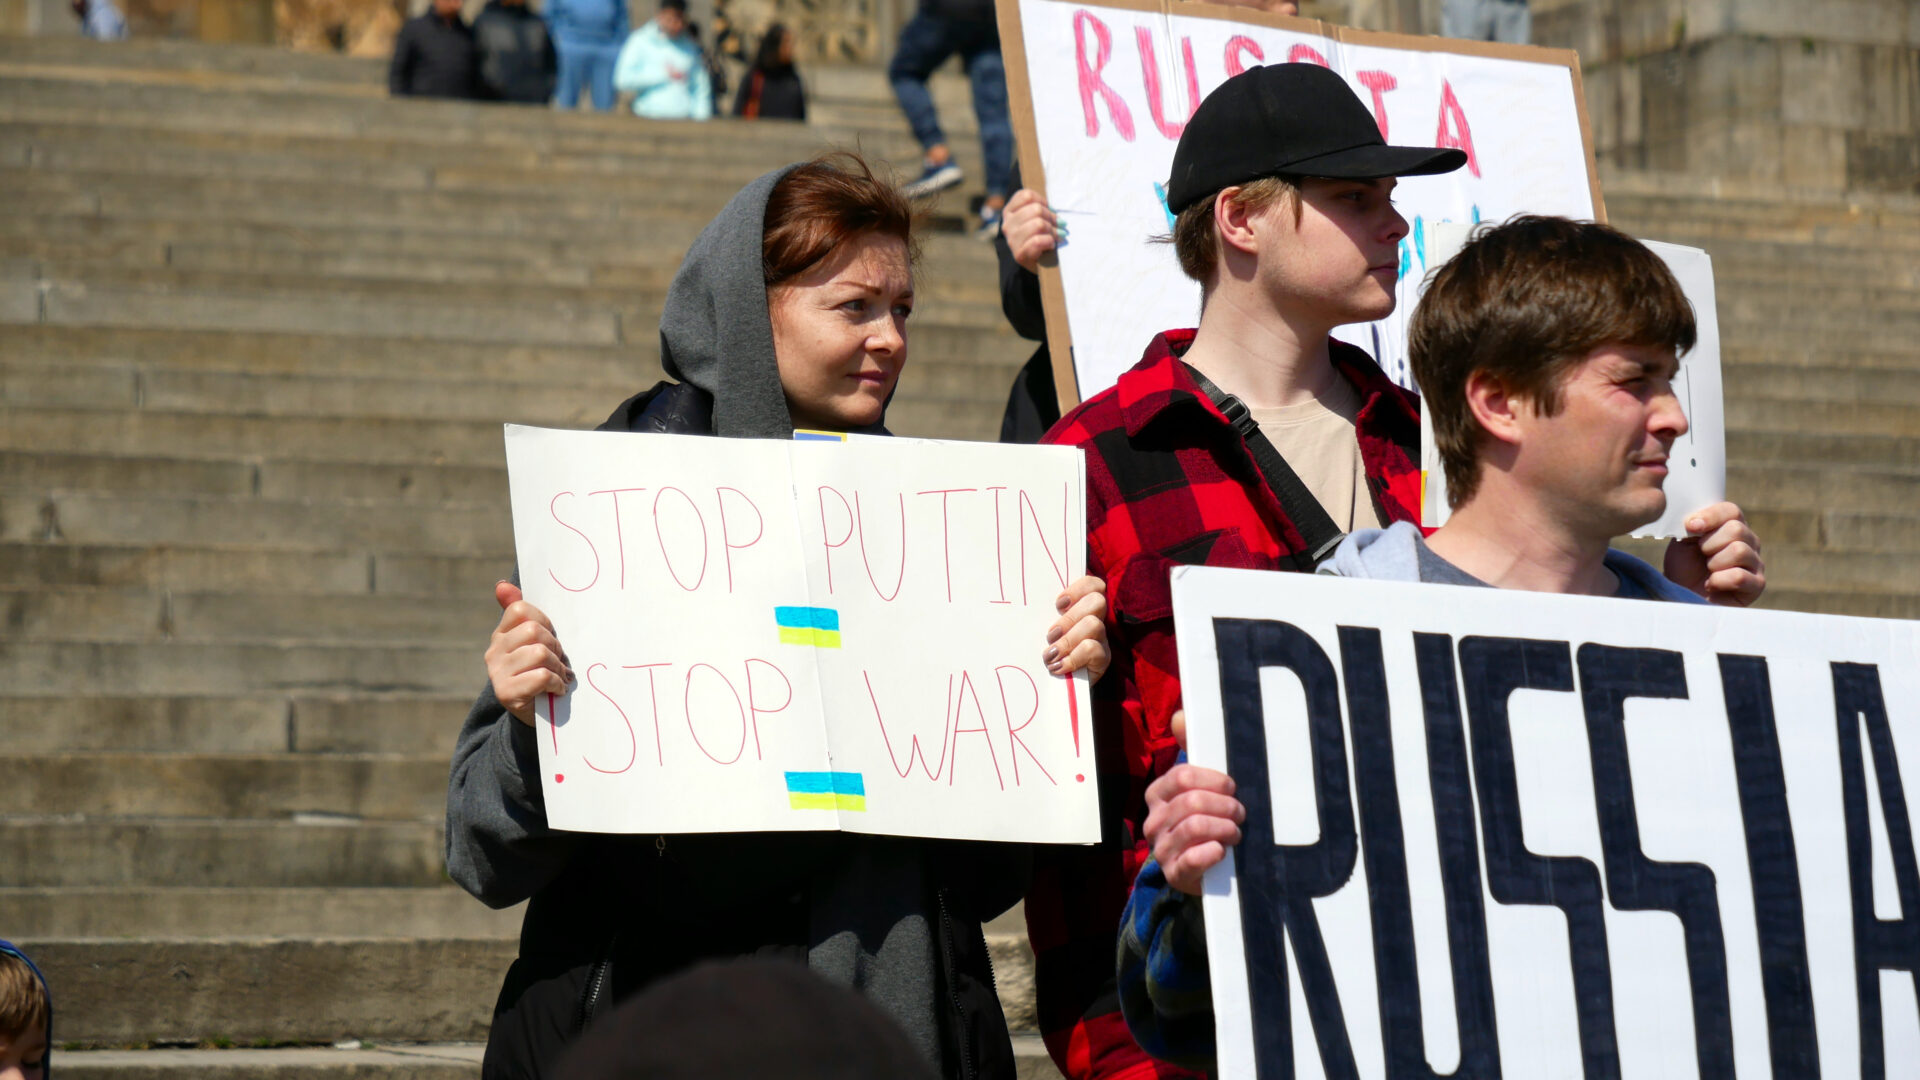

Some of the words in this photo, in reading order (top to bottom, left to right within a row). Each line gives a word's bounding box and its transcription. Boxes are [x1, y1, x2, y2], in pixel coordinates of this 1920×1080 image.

[1073, 9, 1482, 179] RUIA
[548, 485, 763, 593] STOP
[818, 482, 1070, 606] PUTIN
[863, 664, 1086, 791] WAR!
[1211, 616, 1920, 1080] RUSSIA
